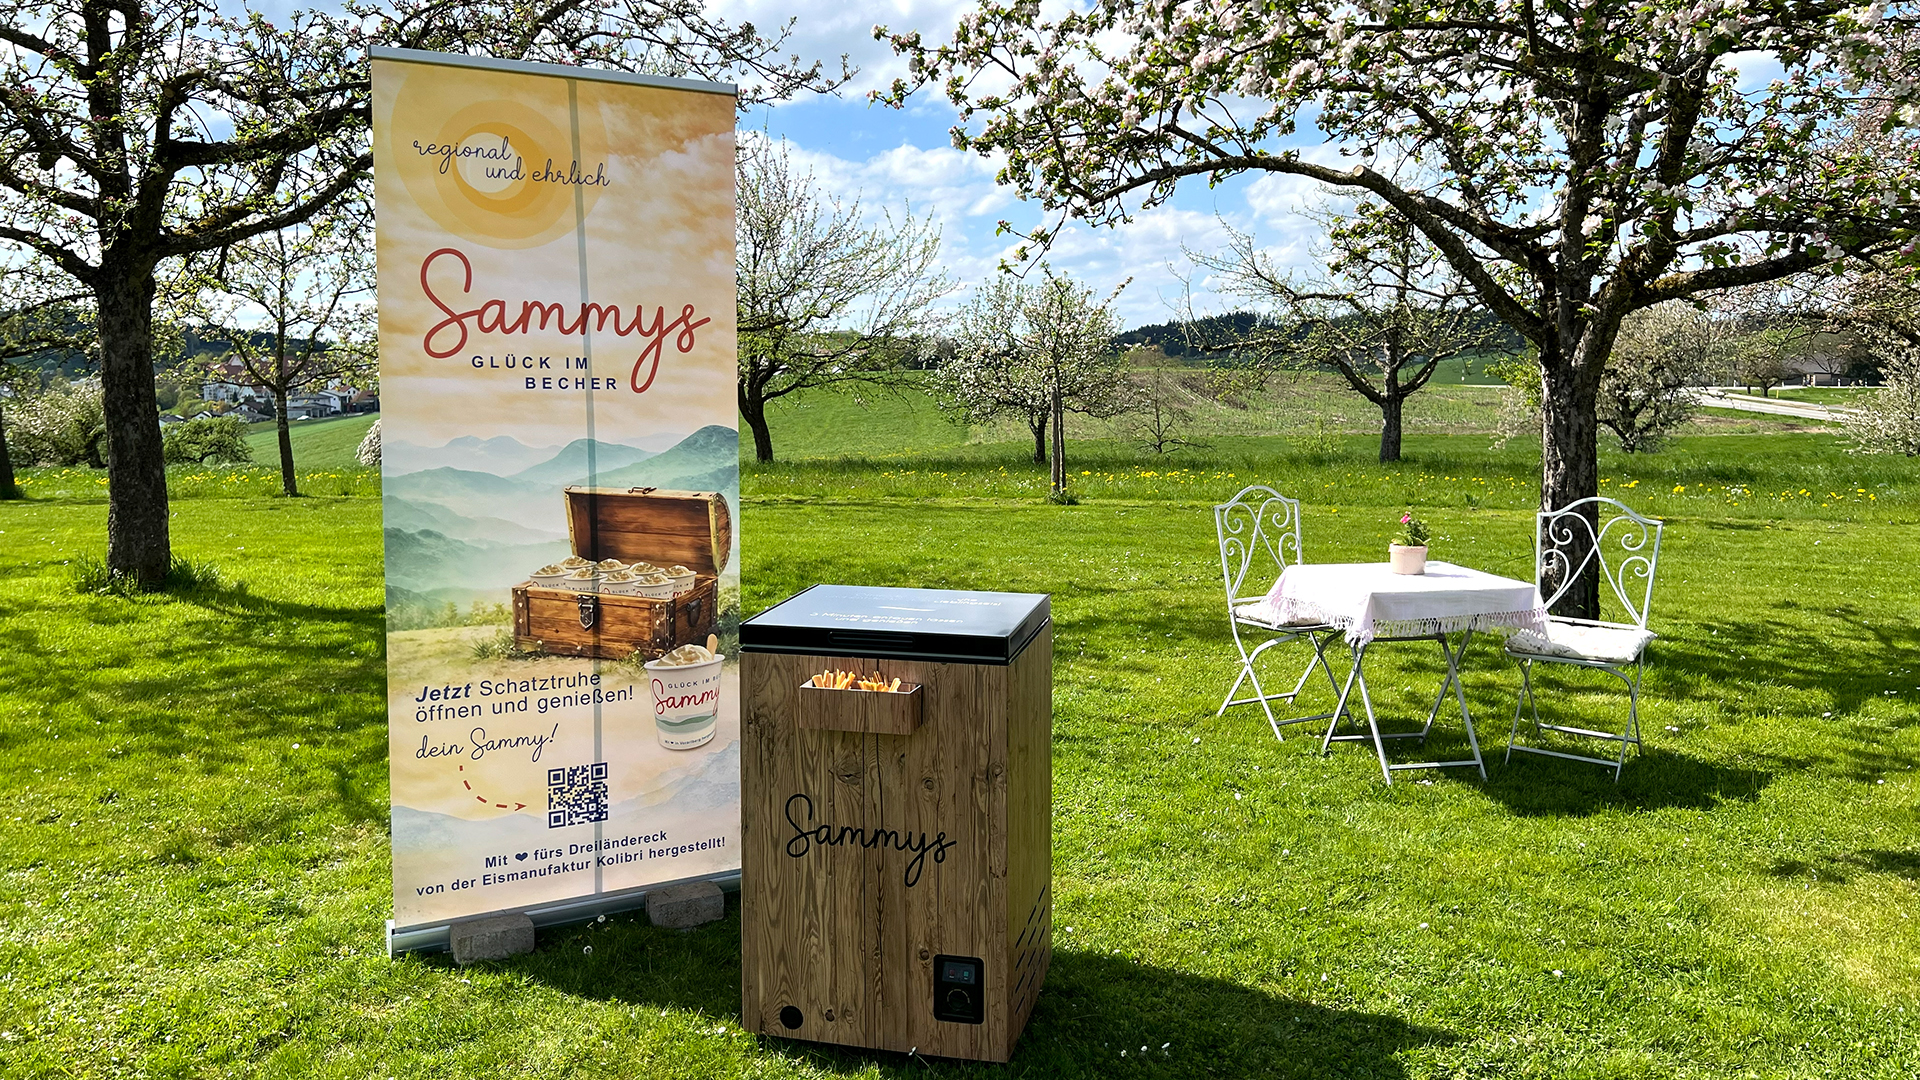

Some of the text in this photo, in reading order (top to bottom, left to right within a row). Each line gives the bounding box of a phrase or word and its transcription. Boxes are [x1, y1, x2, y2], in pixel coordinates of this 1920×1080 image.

[413, 135, 512, 175] regional
[485, 157, 610, 187] und ehrlich
[420, 247, 711, 393] Sammys
[471, 355, 588, 371] GLÜCK IM
[525, 377, 617, 390] BECHER
[415, 686, 633, 722] öffnen und genießen!
[416, 672, 600, 703] Jetzt Schatztruhe
[416, 723, 559, 762] dein Sammy!
[485, 831, 668, 868] Mit fürs Dreiländereck
[787, 793, 957, 887] Sammys
[416, 836, 726, 897] von der Eismanufaktur Kolibri hergestellt!
